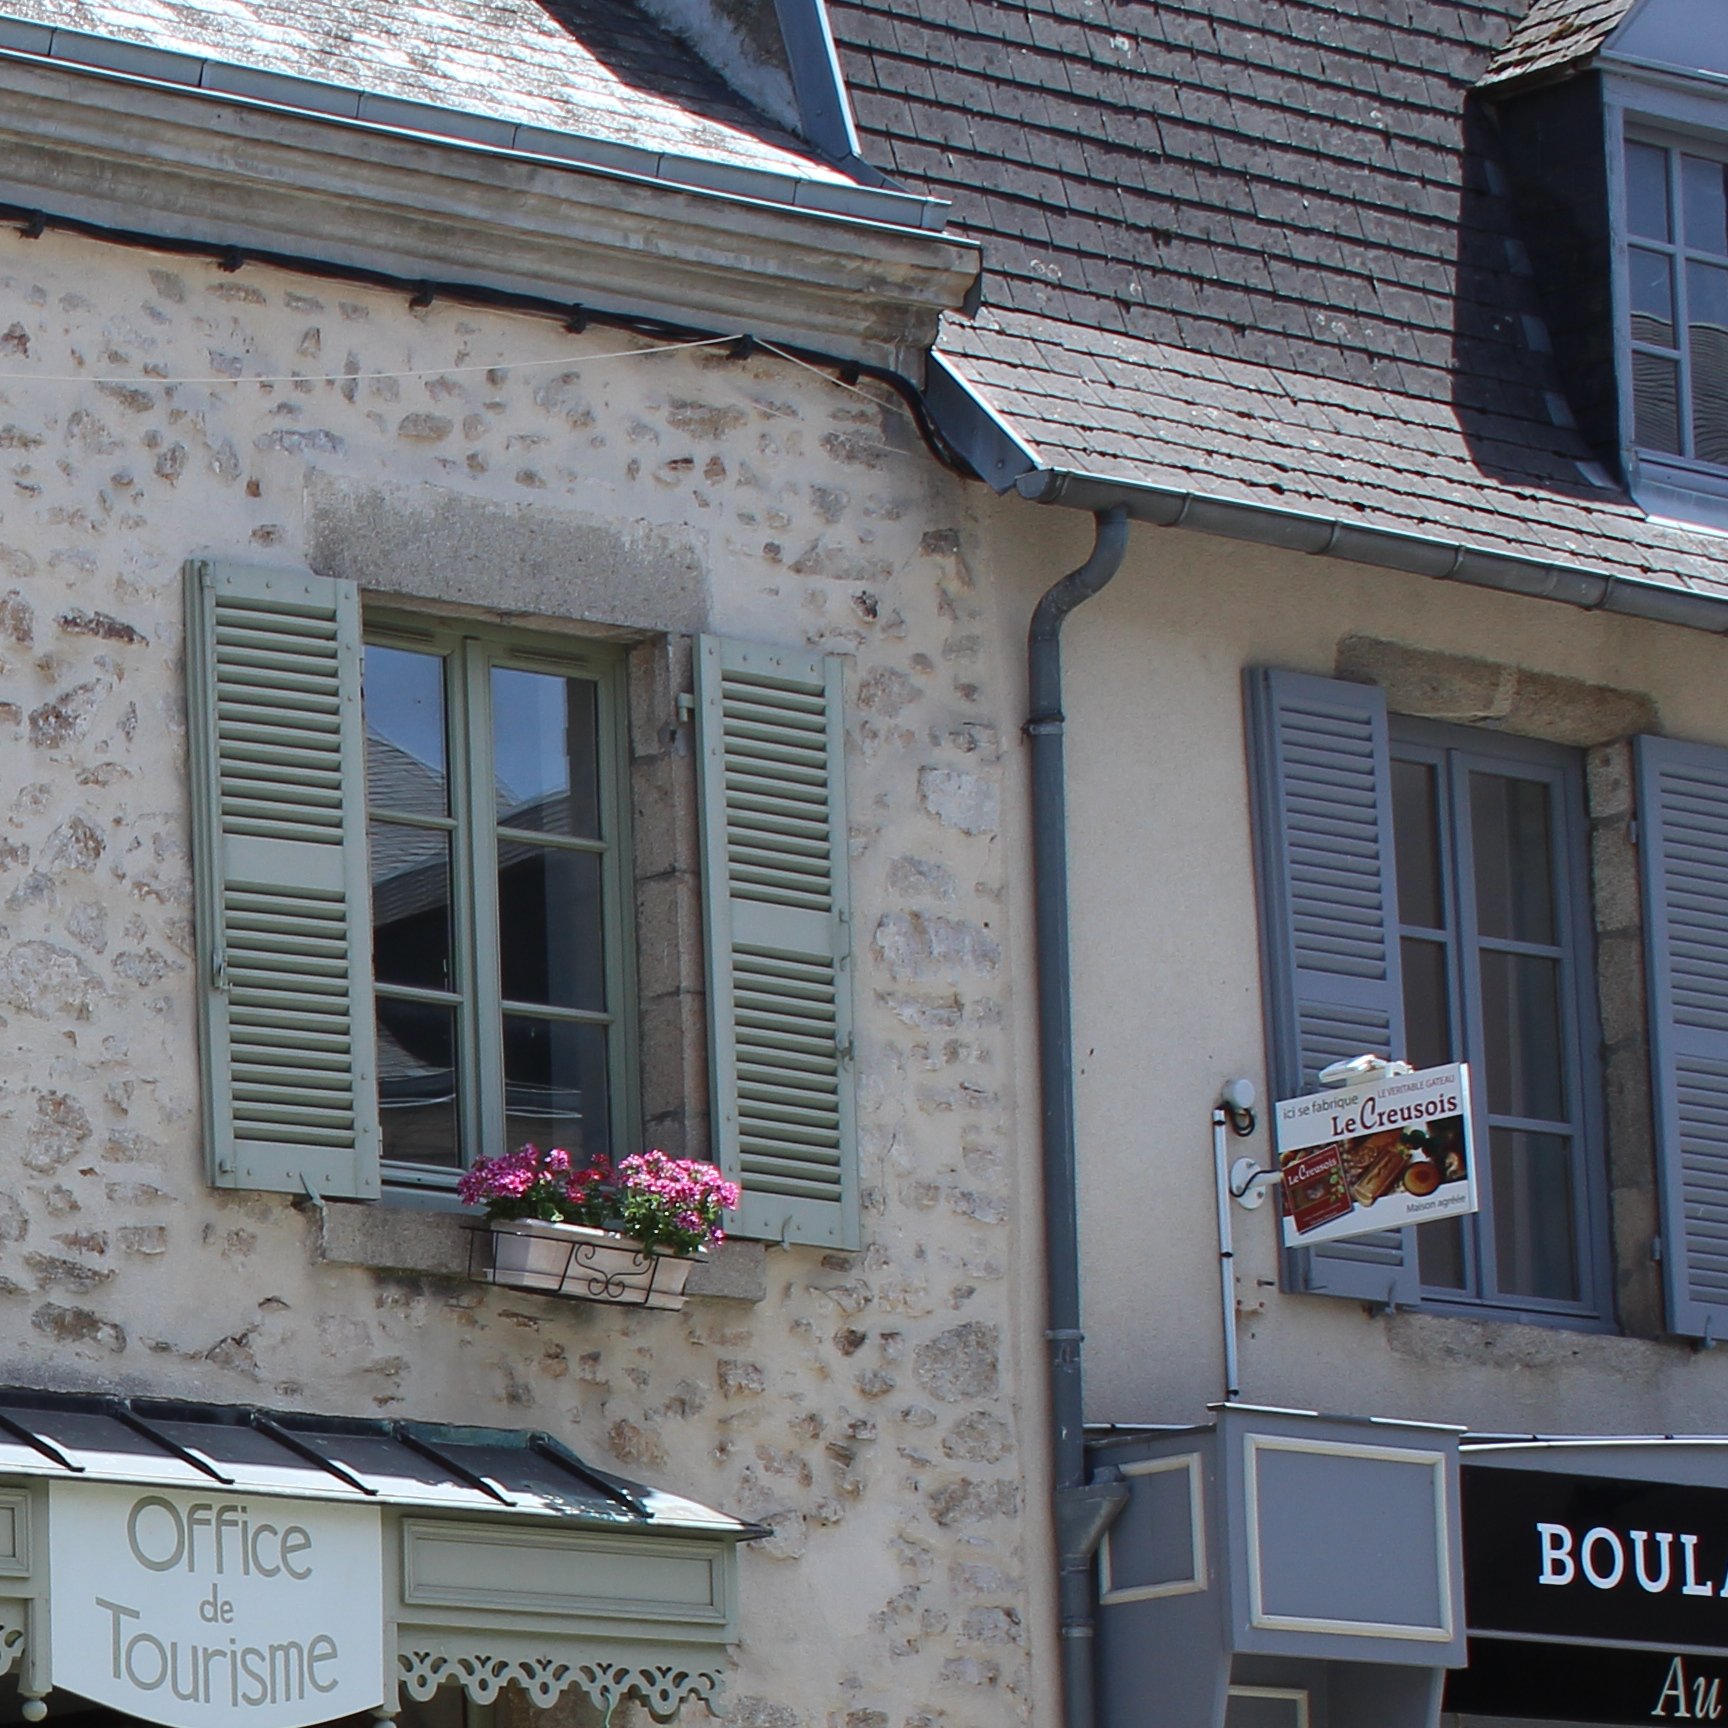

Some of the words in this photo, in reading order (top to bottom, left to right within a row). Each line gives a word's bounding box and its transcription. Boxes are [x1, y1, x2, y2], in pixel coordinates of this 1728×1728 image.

[1283, 1107, 1296, 1120] ici
[1298, 1106, 1310, 1116] se
[1311, 1094, 1359, 1113] fabrique
[1331, 1115, 1356, 1136] Le
[1360, 1093, 1458, 1129] Creusois
[127, 1495, 313, 1580] Office
[1536, 1522, 1728, 1598] BOUL
[199, 1583, 234, 1624] de
[95, 1597, 339, 1707] Tourisme
[1650, 1655, 1722, 1720] Au
